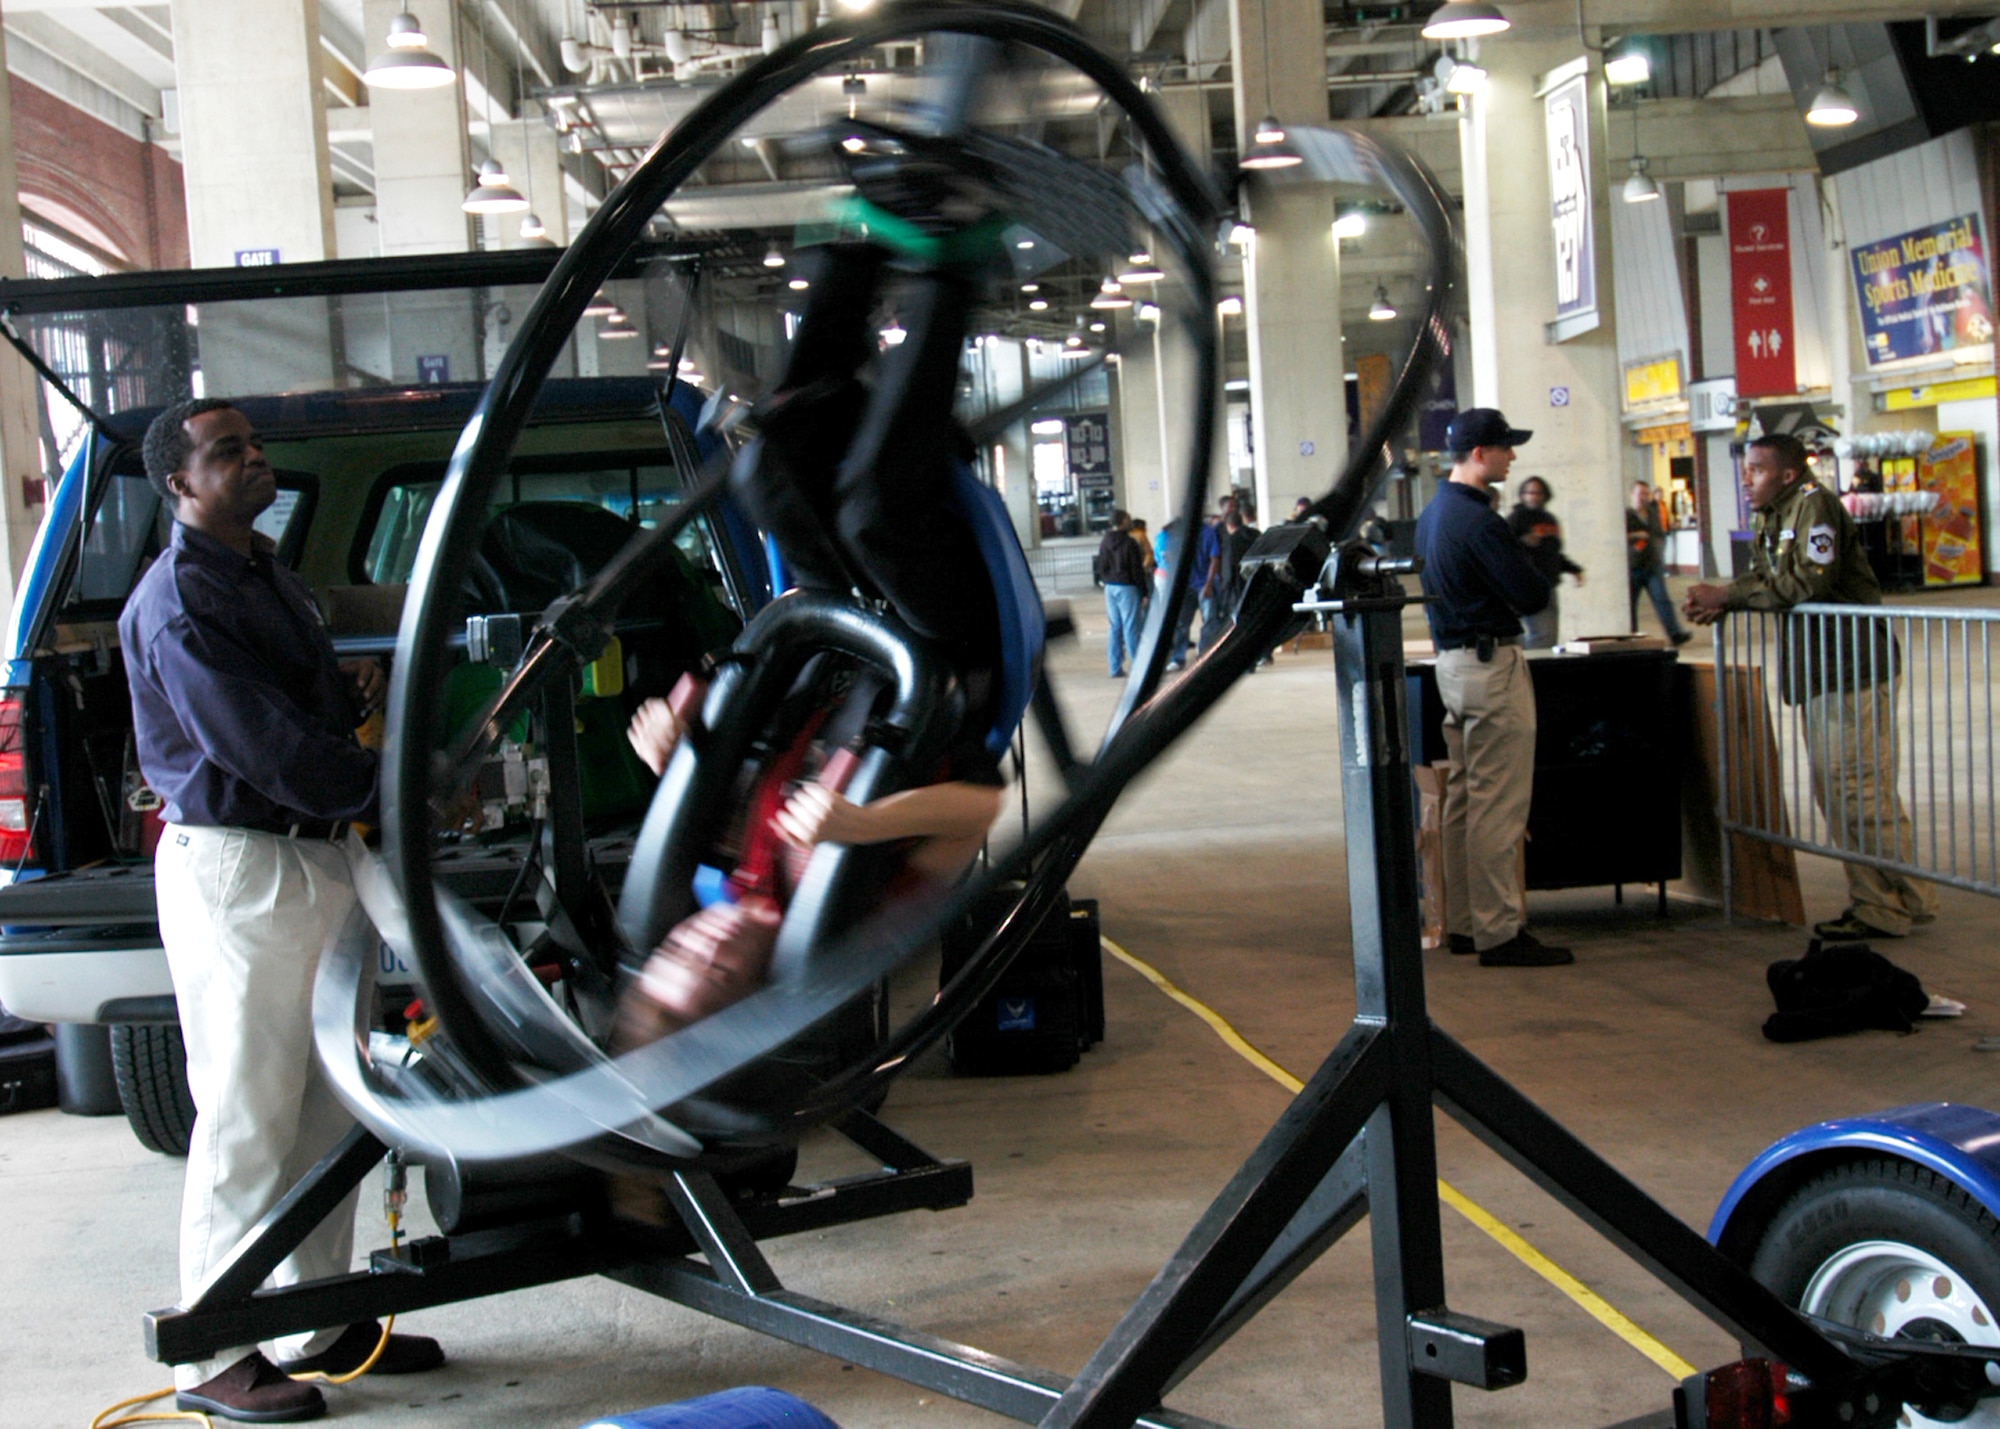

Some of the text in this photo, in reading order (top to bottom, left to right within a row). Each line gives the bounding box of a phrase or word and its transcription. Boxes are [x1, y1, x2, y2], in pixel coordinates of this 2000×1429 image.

[241, 251, 273, 267] GATE
[1858, 217, 1974, 275] Union Memorial
[1865, 277, 1910, 314] Sports
[1909, 257, 1977, 297] Medicine
[422, 357, 444, 369] GATE
